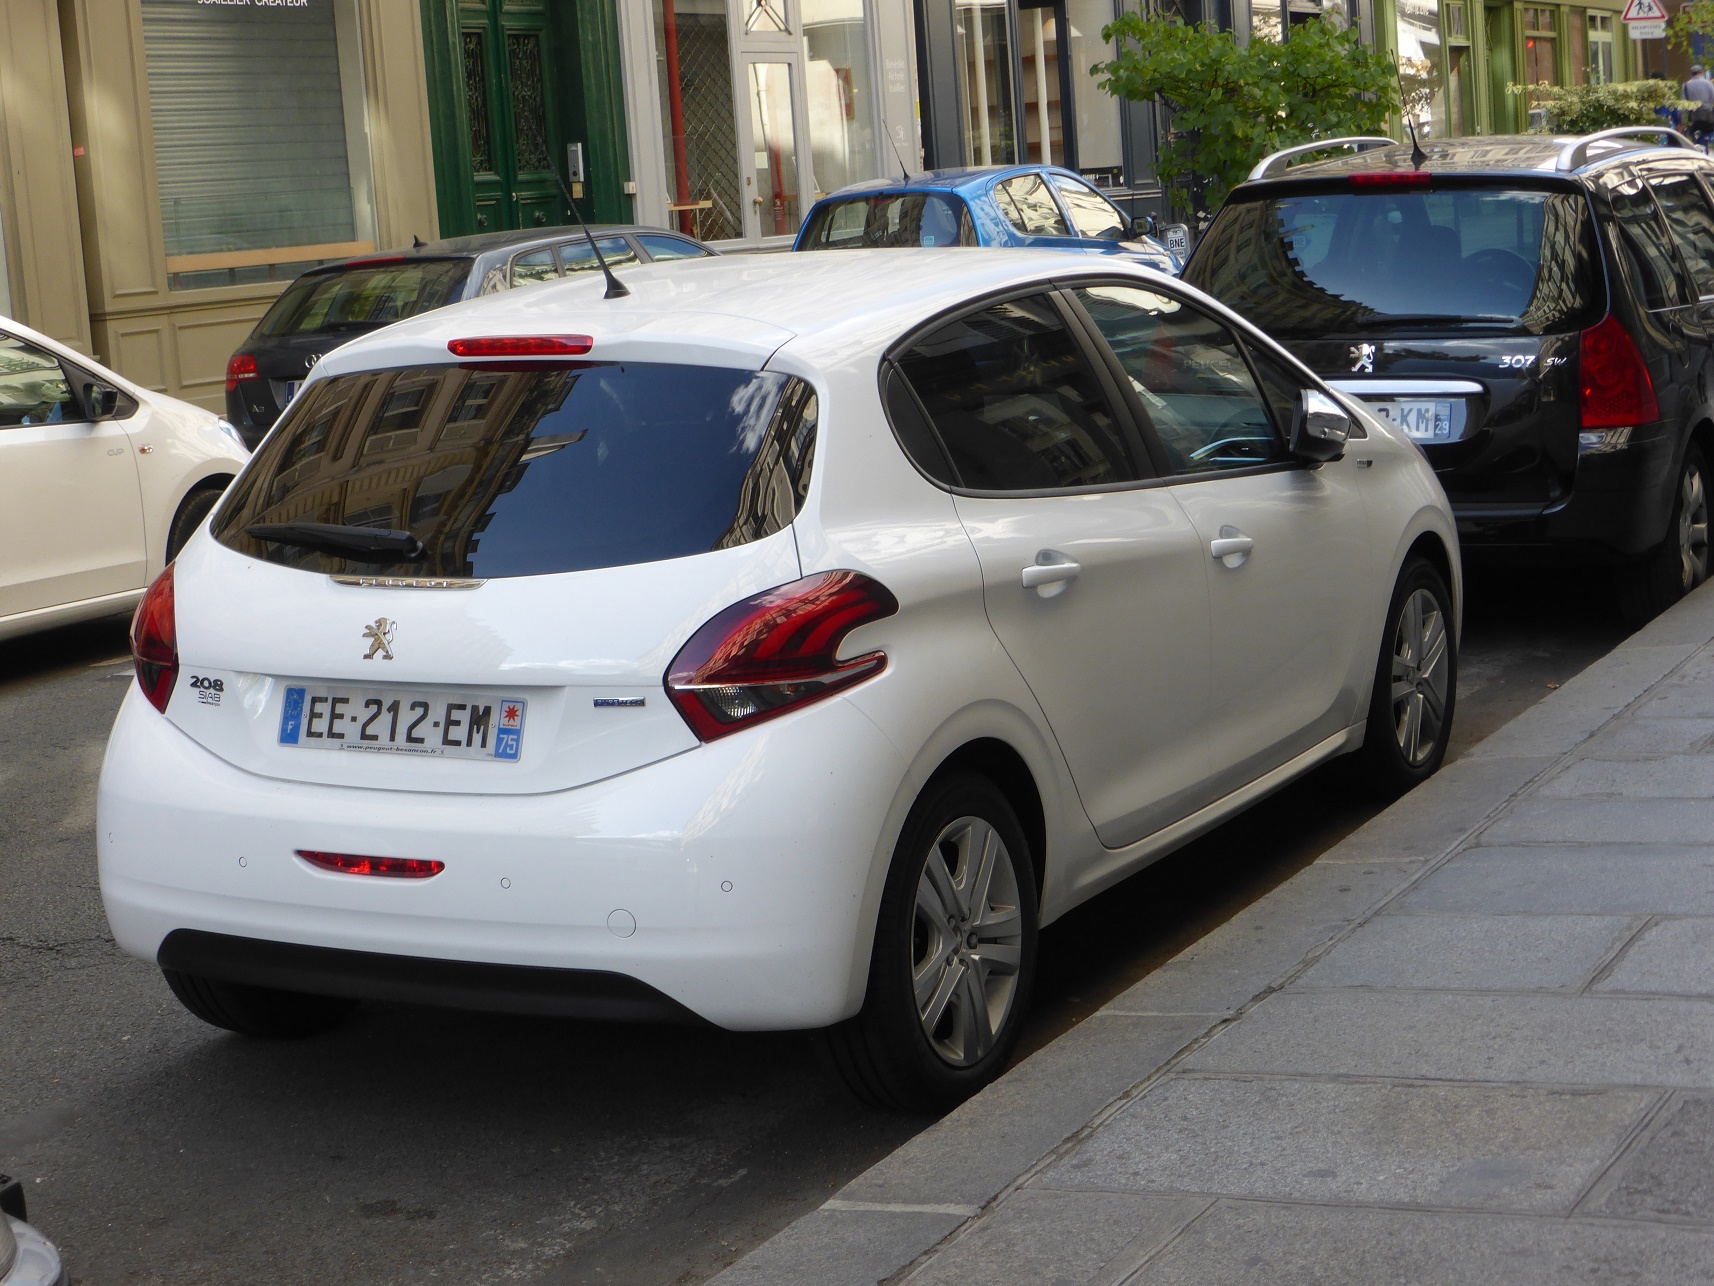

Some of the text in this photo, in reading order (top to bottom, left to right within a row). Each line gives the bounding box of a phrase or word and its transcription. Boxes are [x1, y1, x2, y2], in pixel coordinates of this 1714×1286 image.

[1169, 238, 1185, 248] BNE
[1498, 355, 1567, 368] 307 SW
[252, 404, 265, 413] A3
[1435, 421, 1449, 435] 29
[189, 675, 224, 692] 208
[287, 721, 295, 734] F
[306, 696, 492, 749] EE-212-EM
[498, 734, 518, 754] 75
